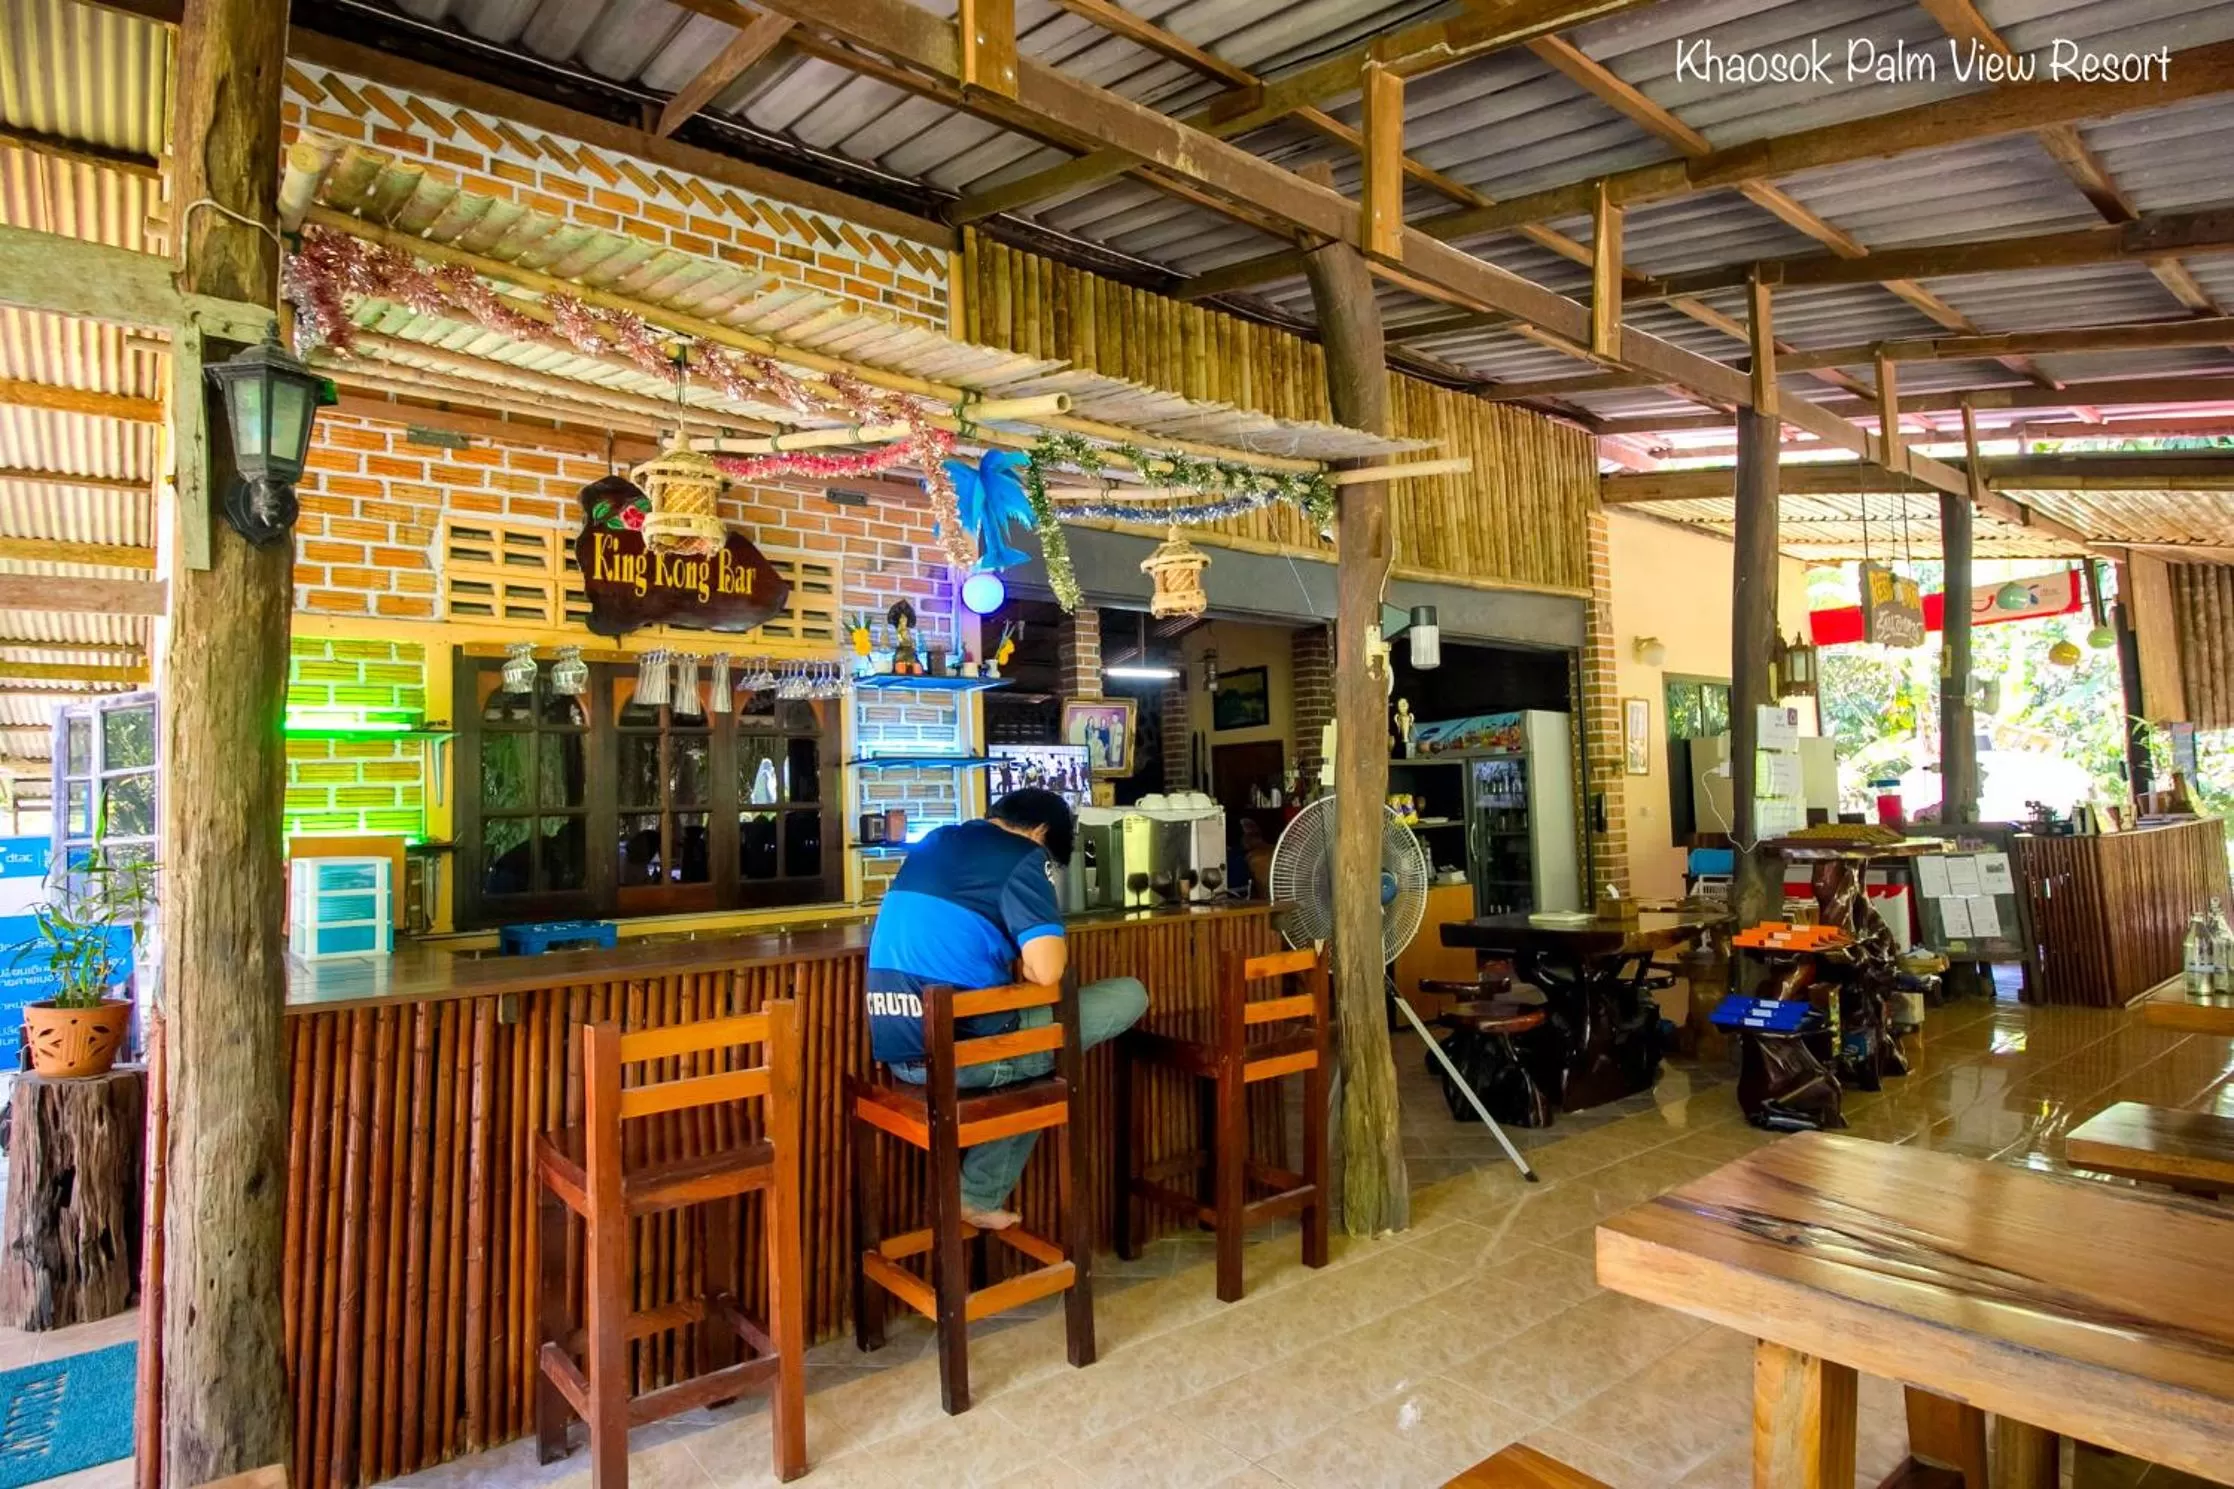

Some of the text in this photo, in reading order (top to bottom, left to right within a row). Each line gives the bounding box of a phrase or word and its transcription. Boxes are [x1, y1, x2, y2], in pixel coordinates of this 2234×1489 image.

[593, 532, 757, 603] King Kong Bar
